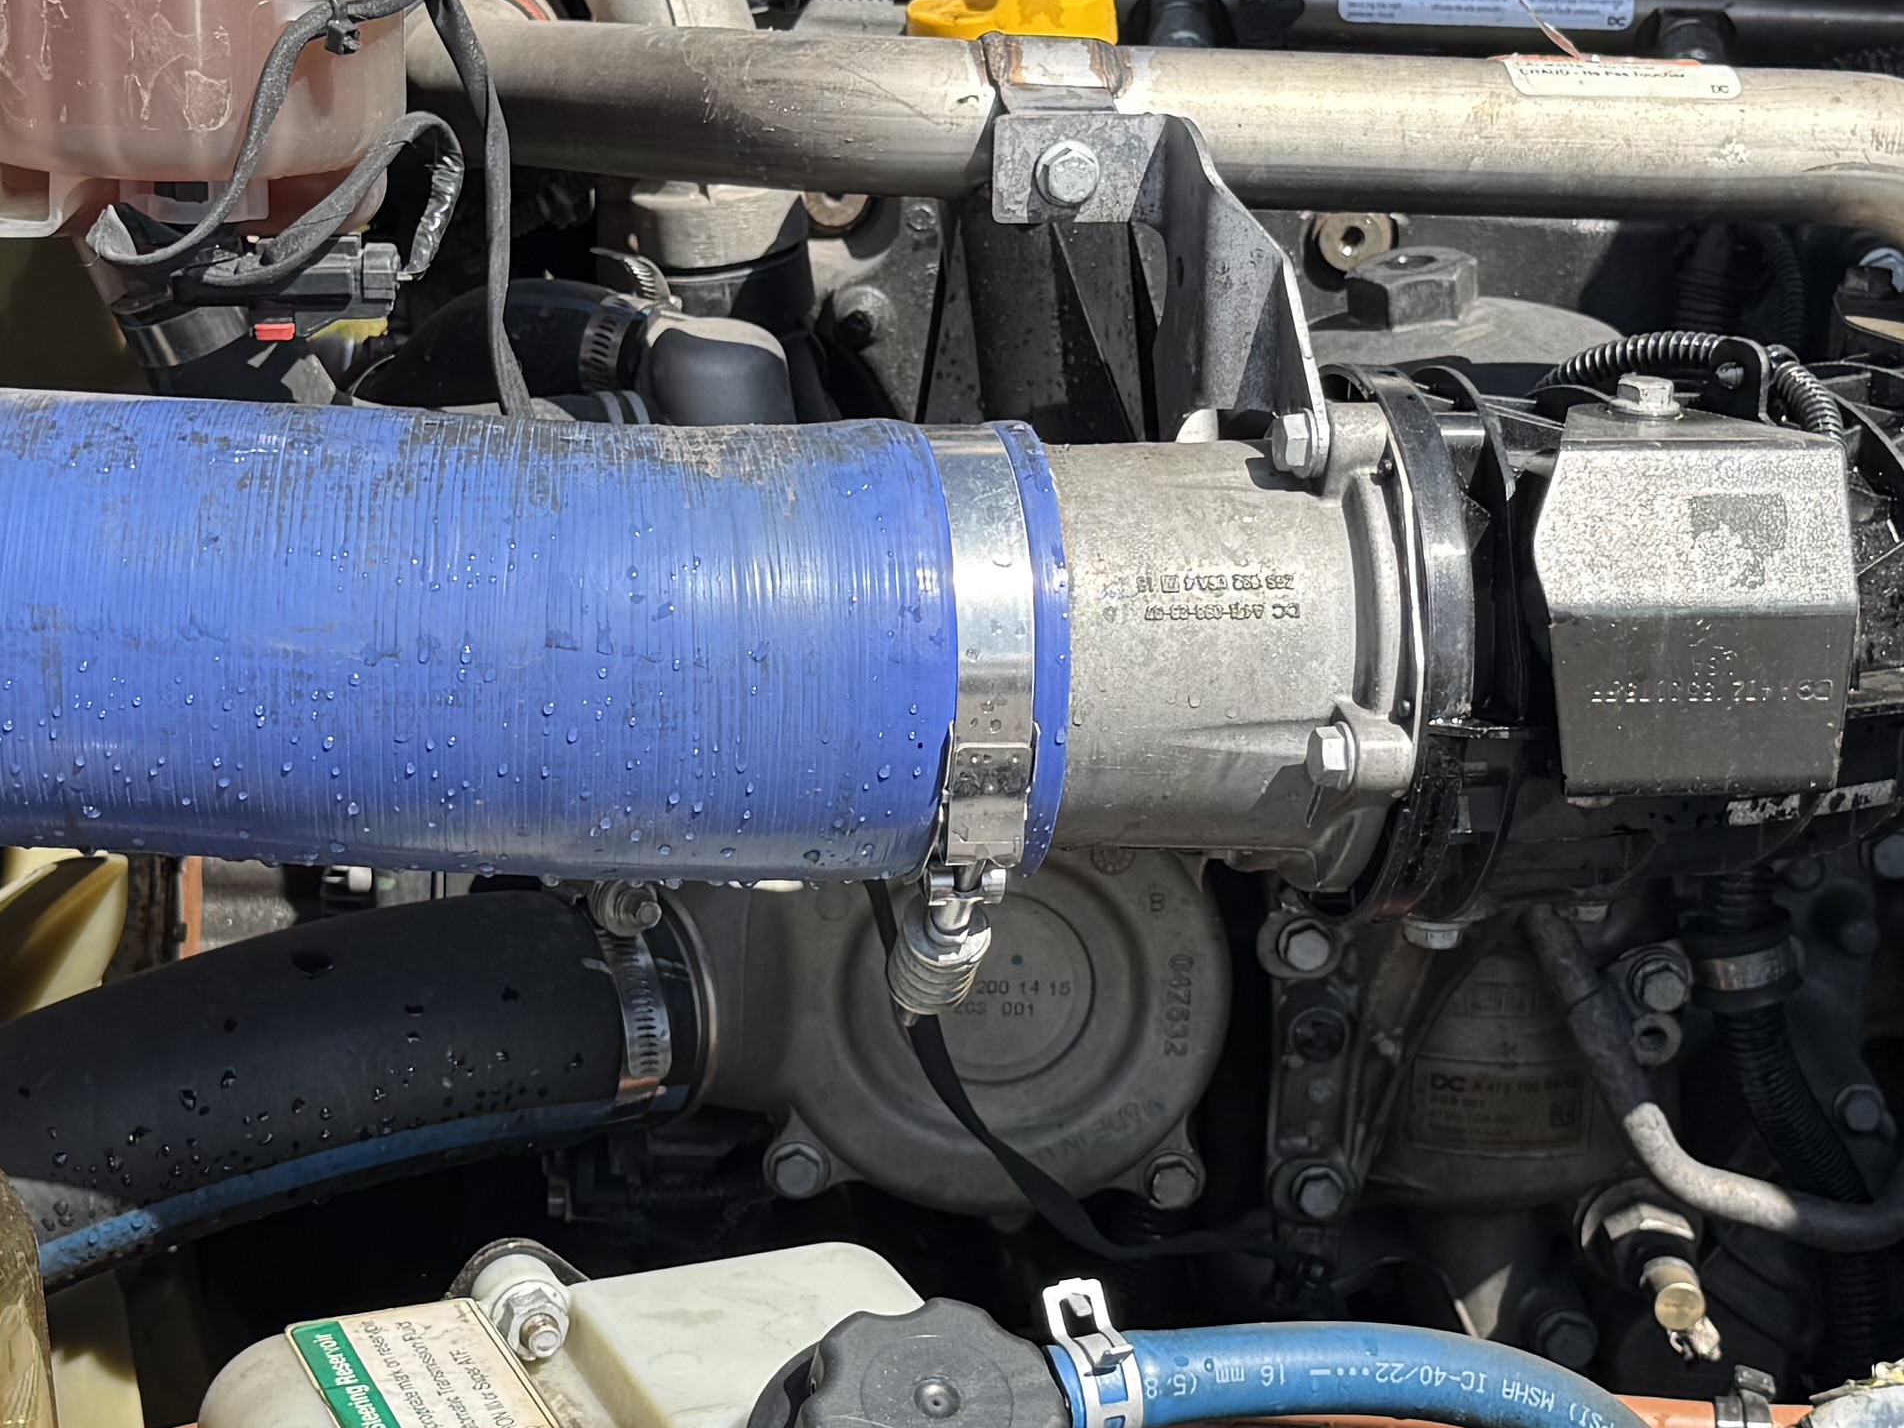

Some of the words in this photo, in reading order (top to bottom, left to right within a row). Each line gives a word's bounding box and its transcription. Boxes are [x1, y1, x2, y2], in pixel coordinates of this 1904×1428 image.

[1607, 16, 1627, 27] DC
[1710, 84, 1730, 95] DC
[977, 980, 1009, 995] 200
[1019, 980, 1039, 996] 14
[1001, 1003, 1034, 1017] 001
[313, 1332, 359, 1386] Reservoir
[1215, 1366, 1245, 1383] mm
[1261, 1364, 1286, 1386] 16
[1502, 1379, 1556, 1412] MSHA
